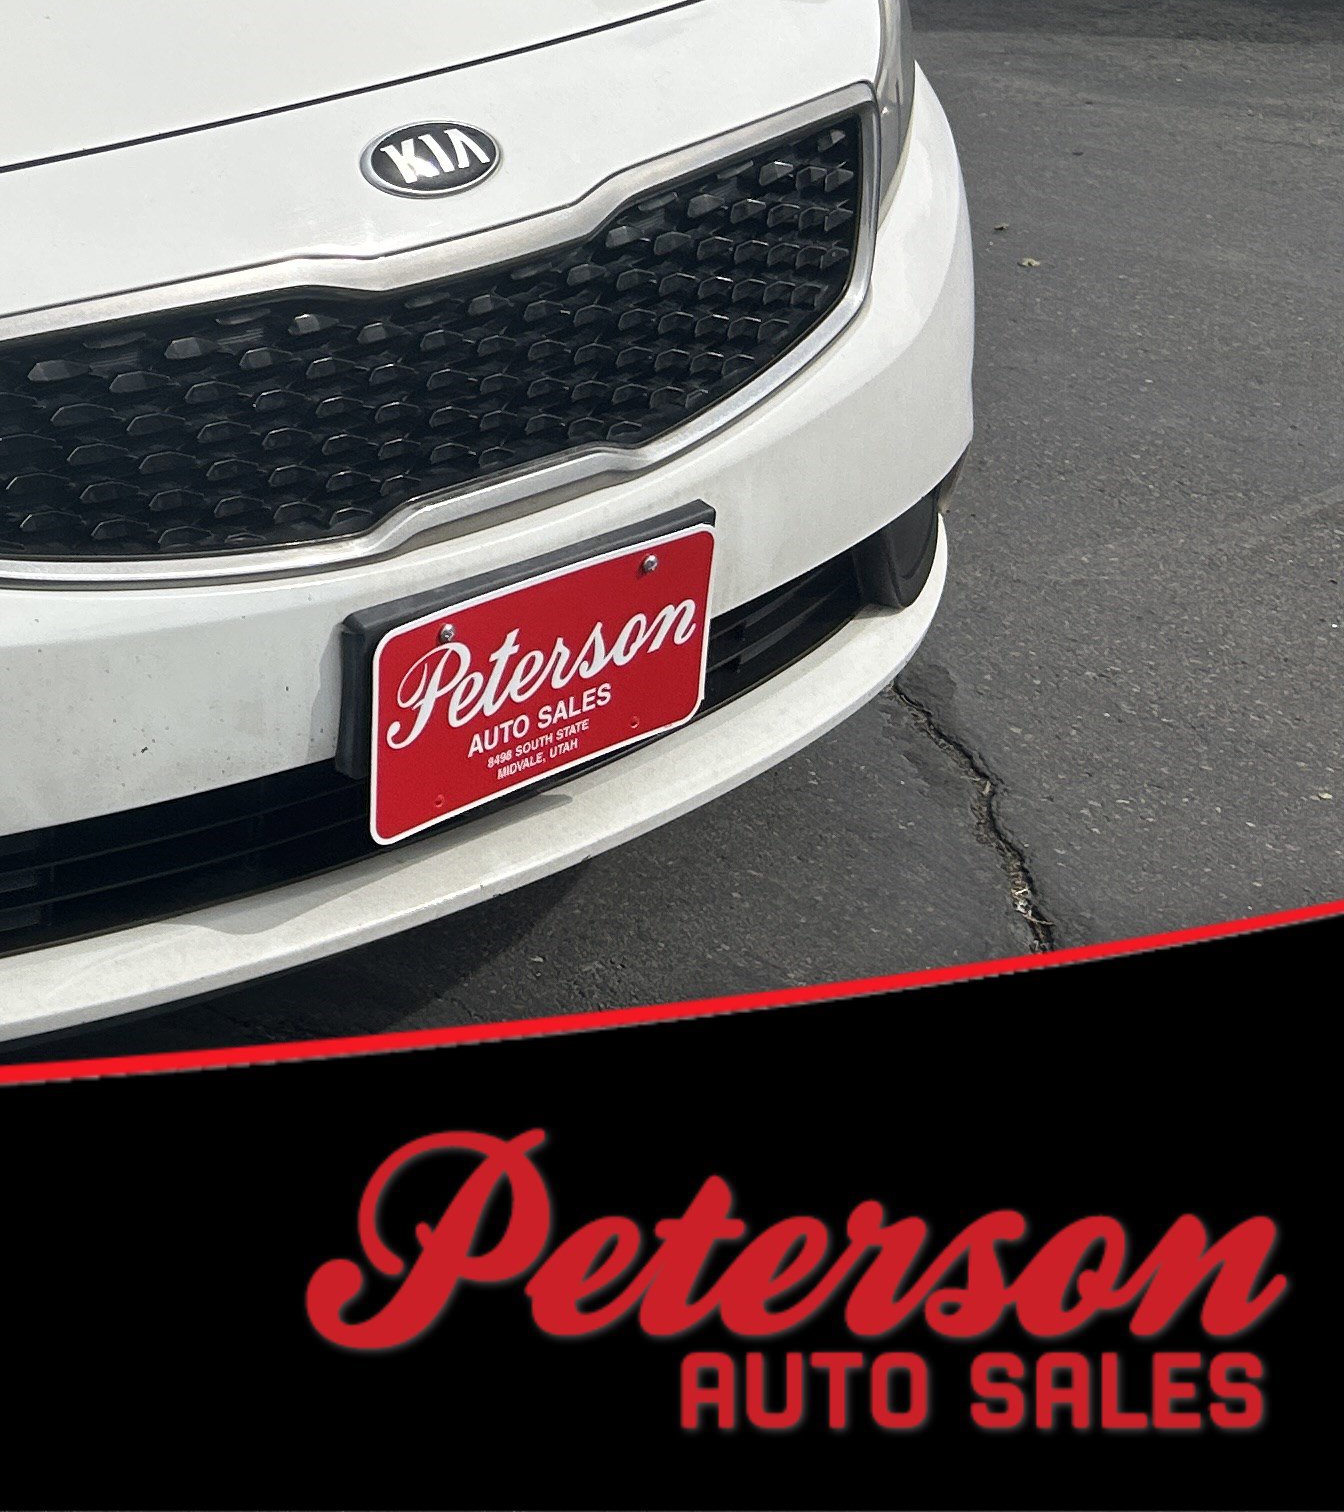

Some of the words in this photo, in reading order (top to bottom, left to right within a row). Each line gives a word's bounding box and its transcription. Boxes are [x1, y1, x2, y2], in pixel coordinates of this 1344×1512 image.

[380, 128, 491, 184] KIA
[386, 597, 697, 750] Peterson
[467, 714, 530, 759] AUTO
[537, 682, 612, 729] SALES
[487, 749, 513, 769] 8498
[515, 732, 554, 758] SOUTH
[556, 718, 590, 740] STATE
[549, 738, 579, 759] UTAH
